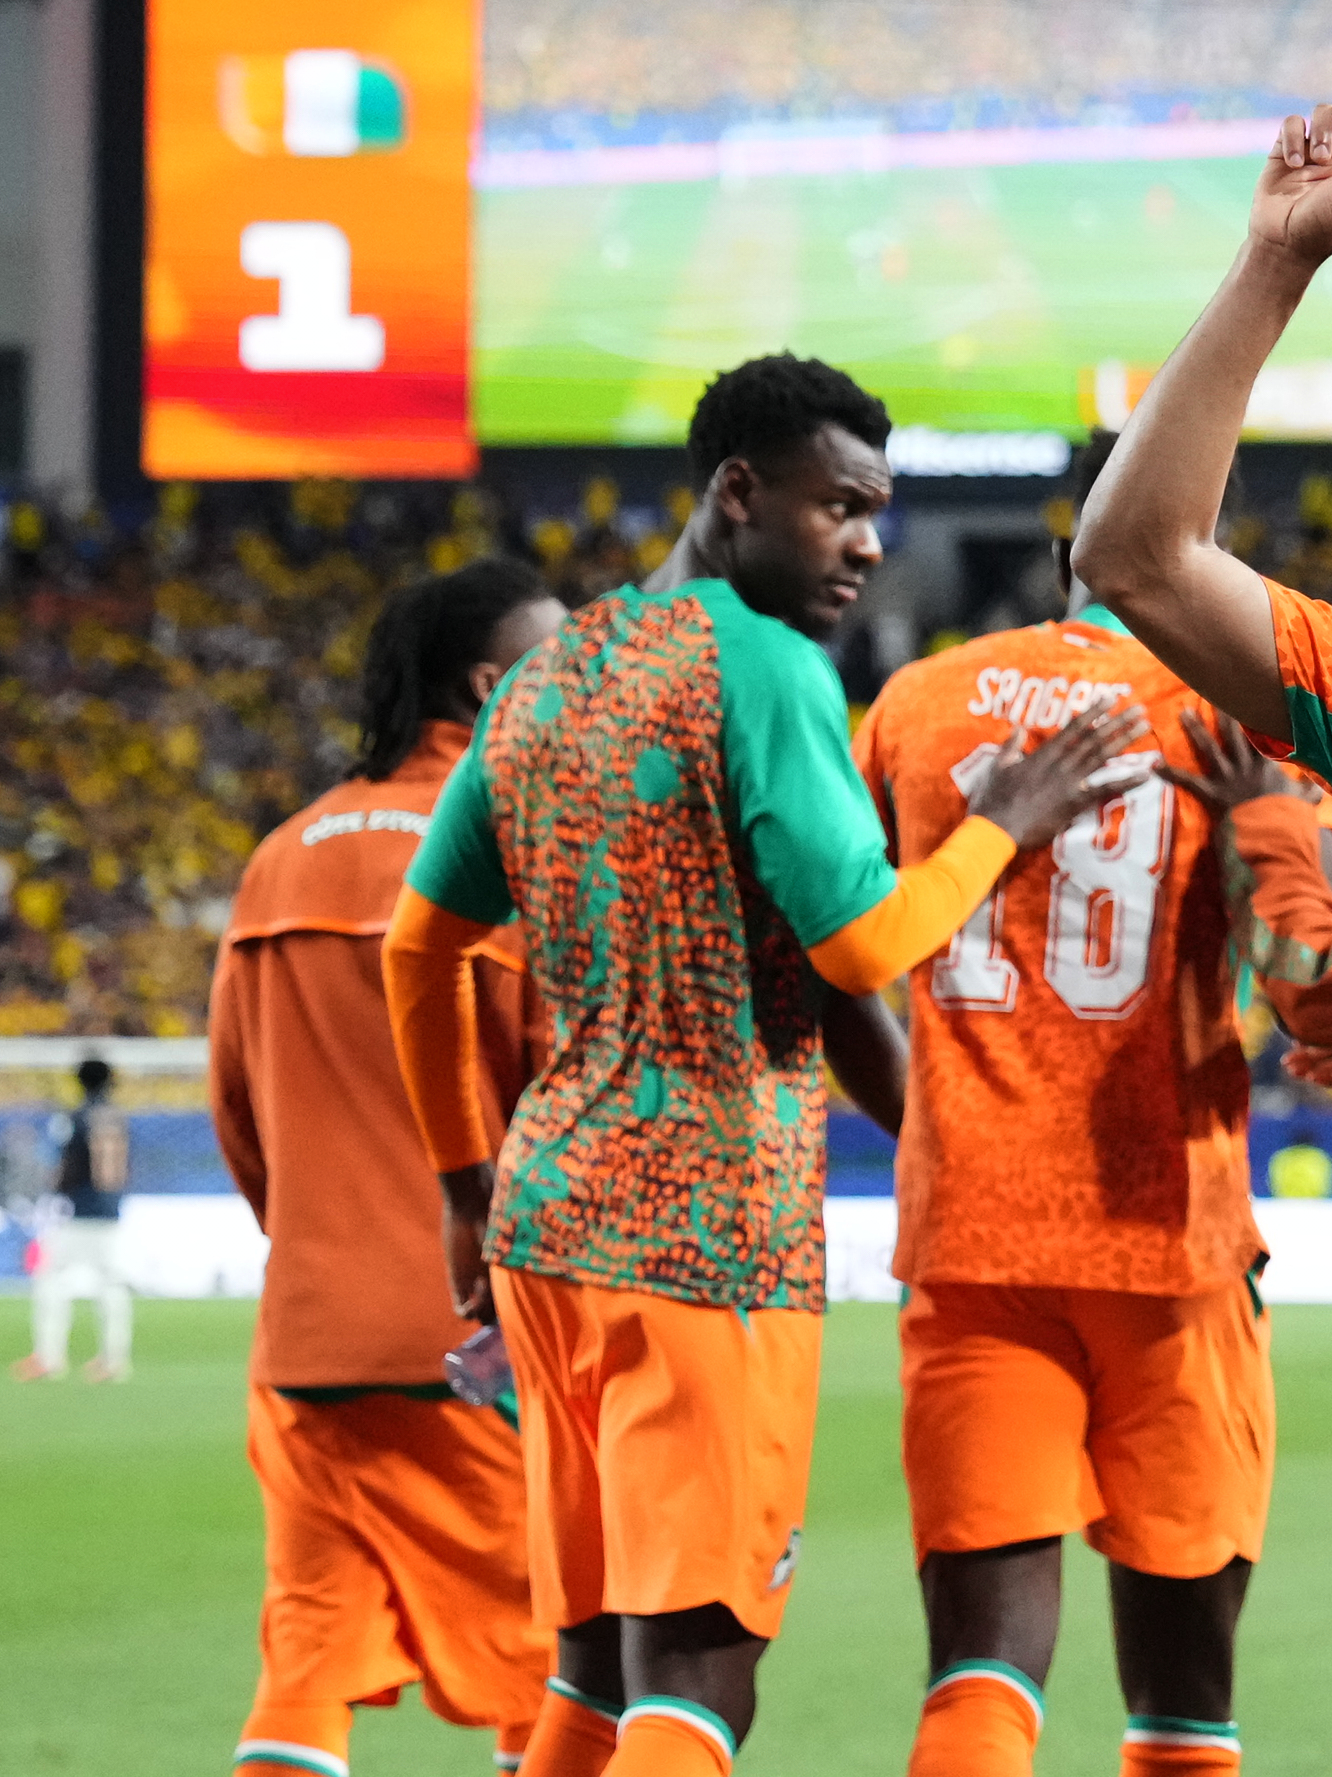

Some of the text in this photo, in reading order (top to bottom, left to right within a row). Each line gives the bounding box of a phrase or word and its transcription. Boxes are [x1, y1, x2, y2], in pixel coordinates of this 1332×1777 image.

[239, 221, 386, 372] 1
[968, 667, 1131, 730] SANGA
[931, 742, 1176, 1020] 18
